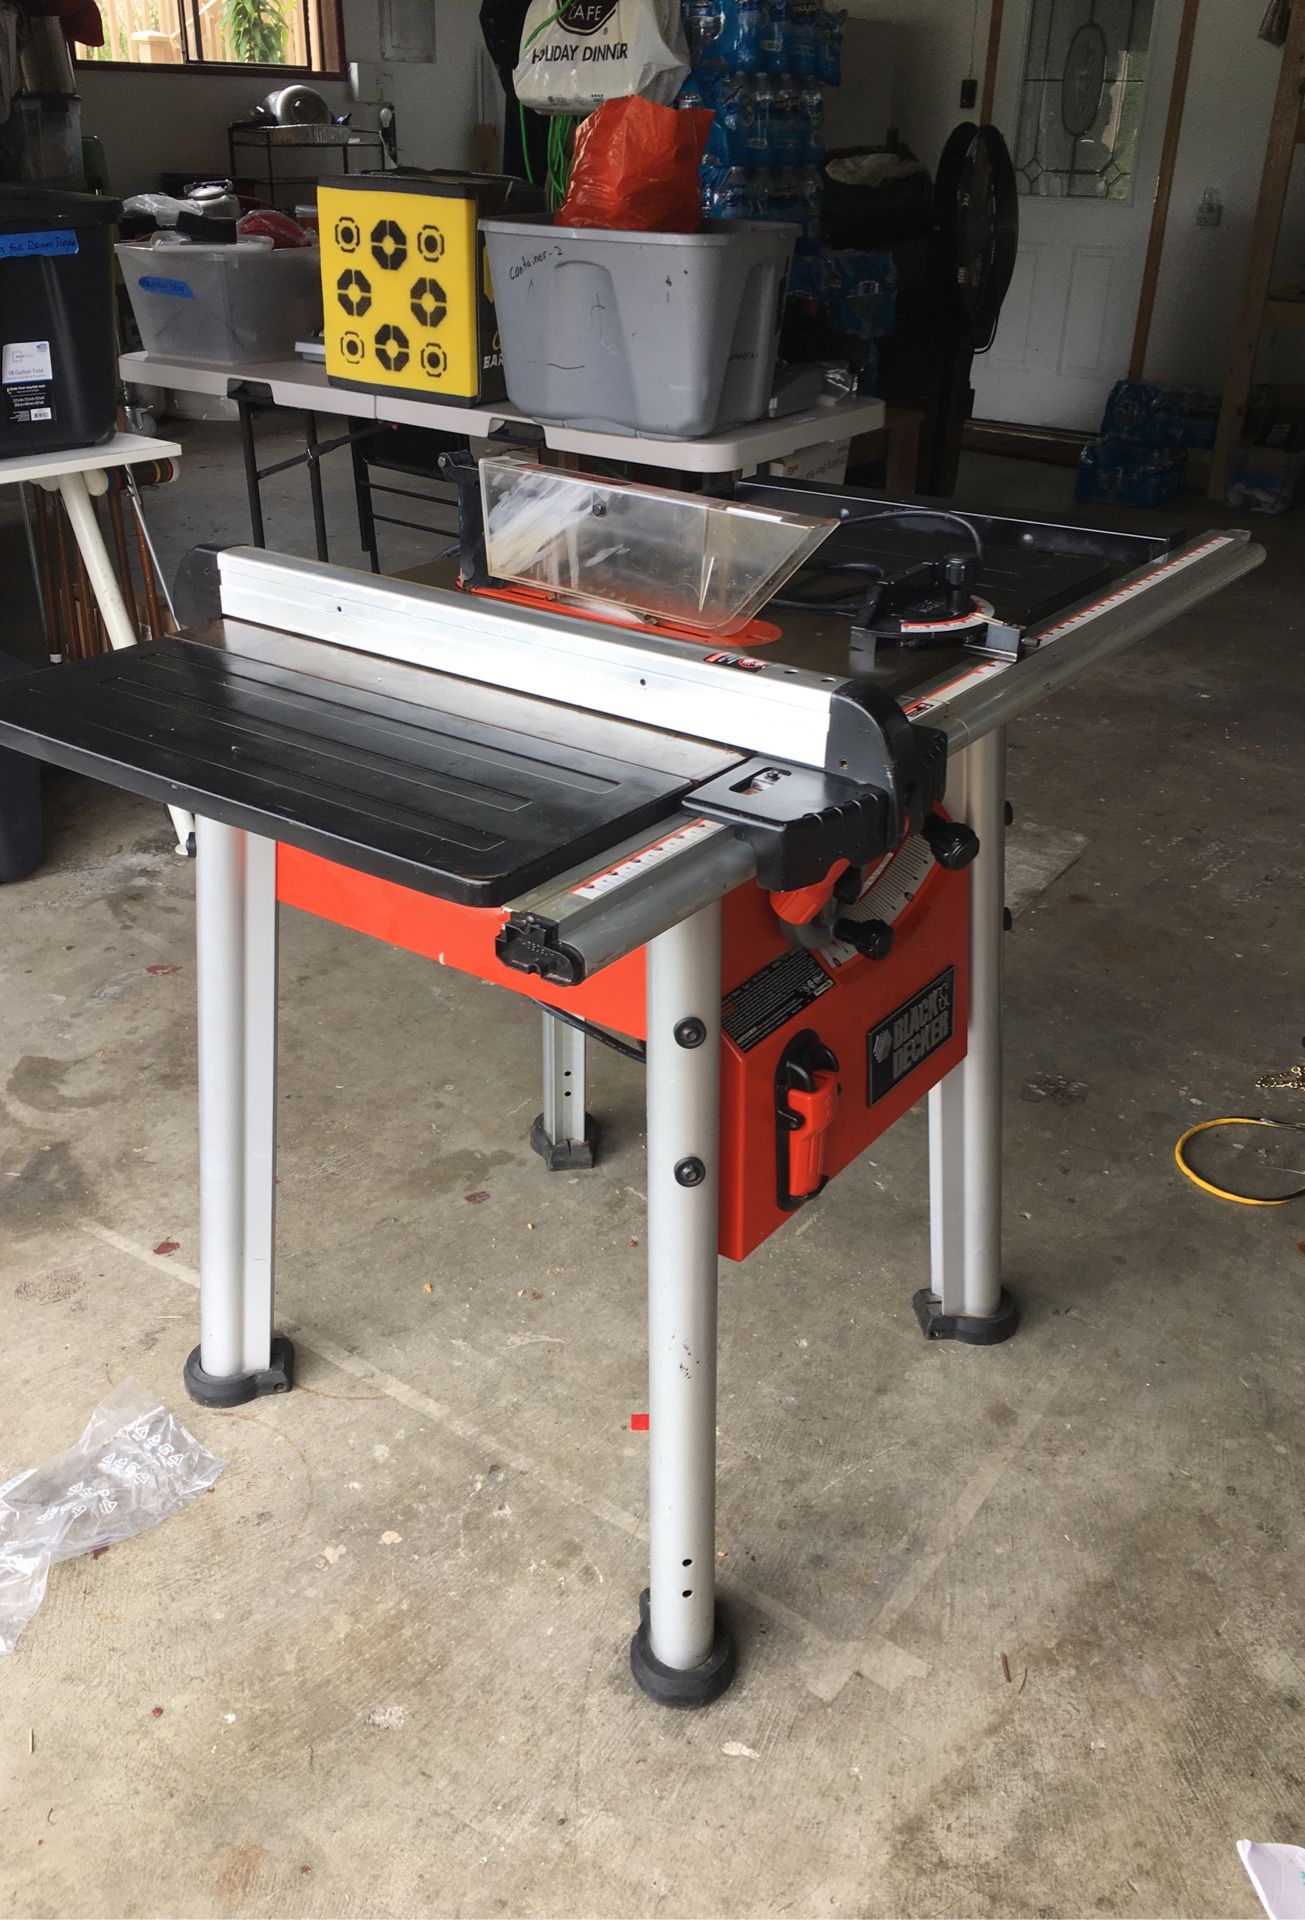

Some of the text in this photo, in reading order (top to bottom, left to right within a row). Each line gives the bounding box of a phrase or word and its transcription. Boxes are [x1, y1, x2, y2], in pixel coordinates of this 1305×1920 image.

[569, 4, 602, 21] CAFE
[893, 988, 942, 1052] BLACK
[893, 1009, 949, 1081] DECKER
